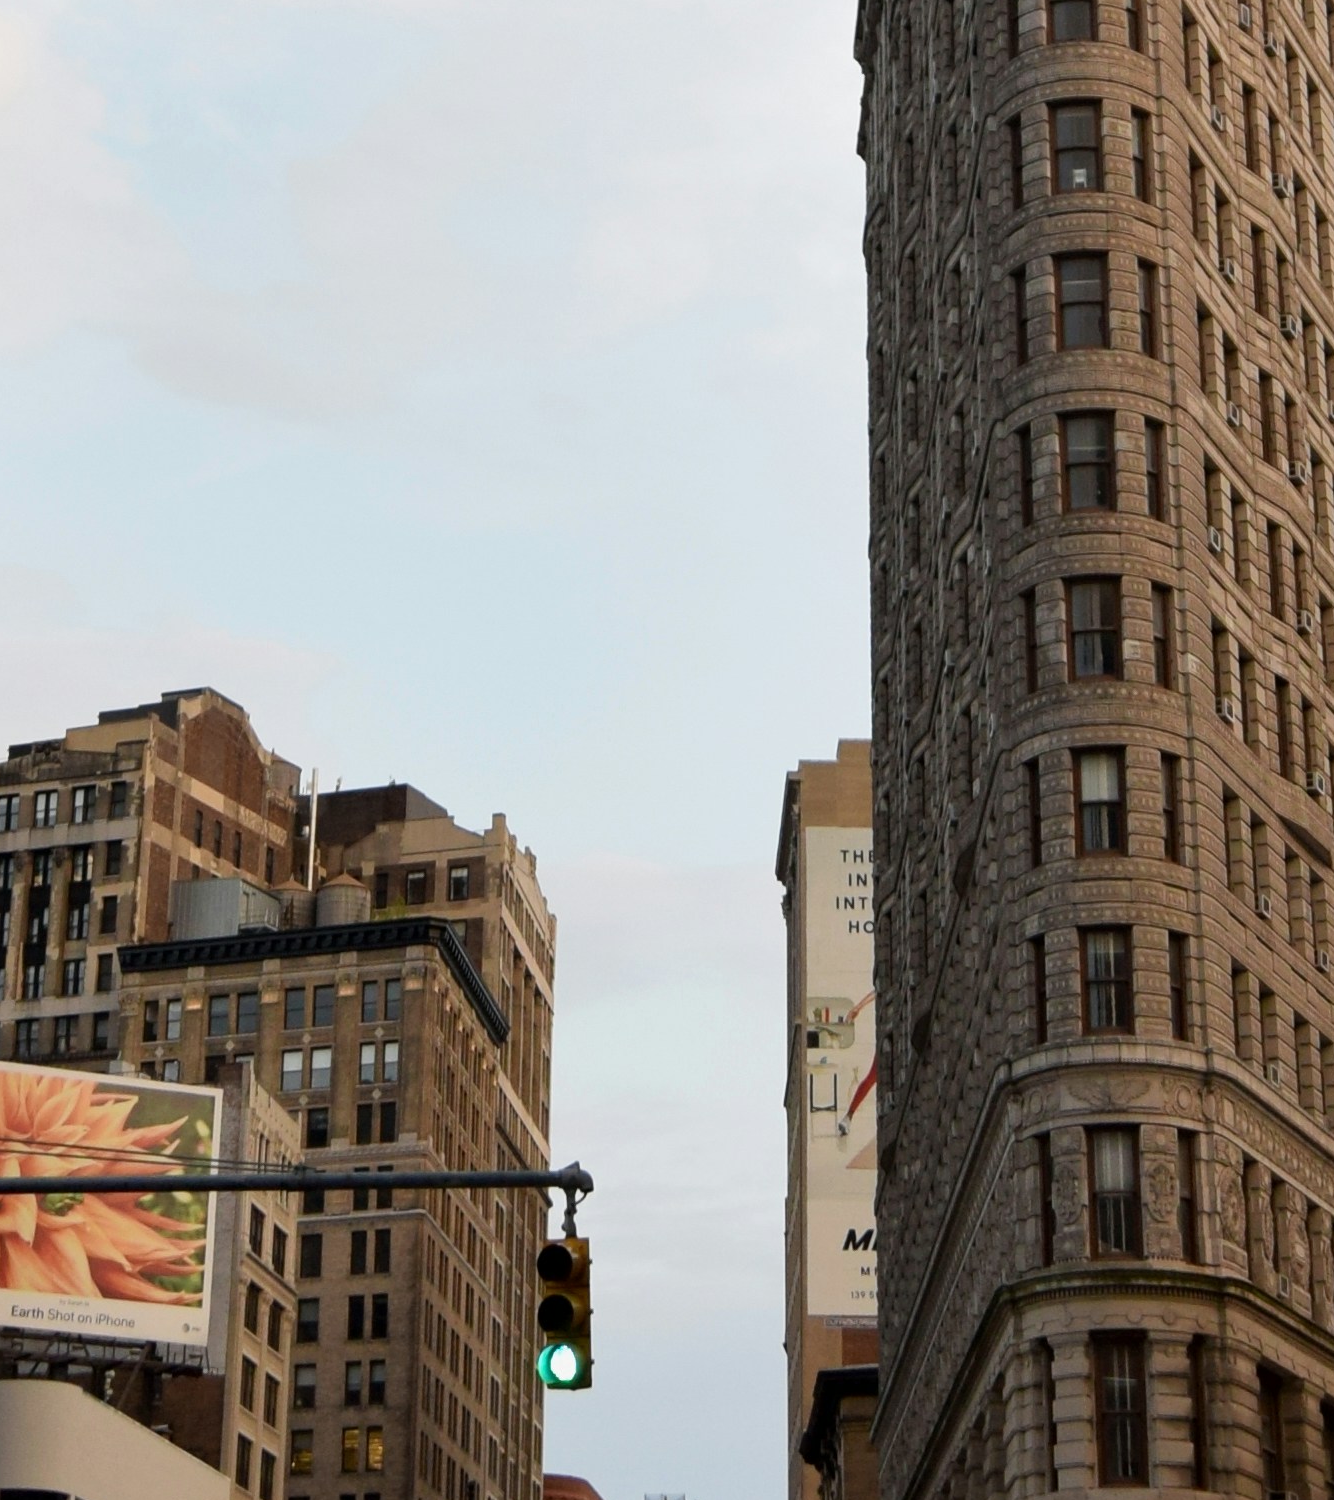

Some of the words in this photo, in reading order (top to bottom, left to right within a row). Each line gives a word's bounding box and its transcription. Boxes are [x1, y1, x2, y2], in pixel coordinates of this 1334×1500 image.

[11, 1304, 45, 1320] Earth
[47, 1307, 75, 1323] Shot
[77, 1313, 93, 1324] on
[95, 1313, 136, 1329] iPhone
